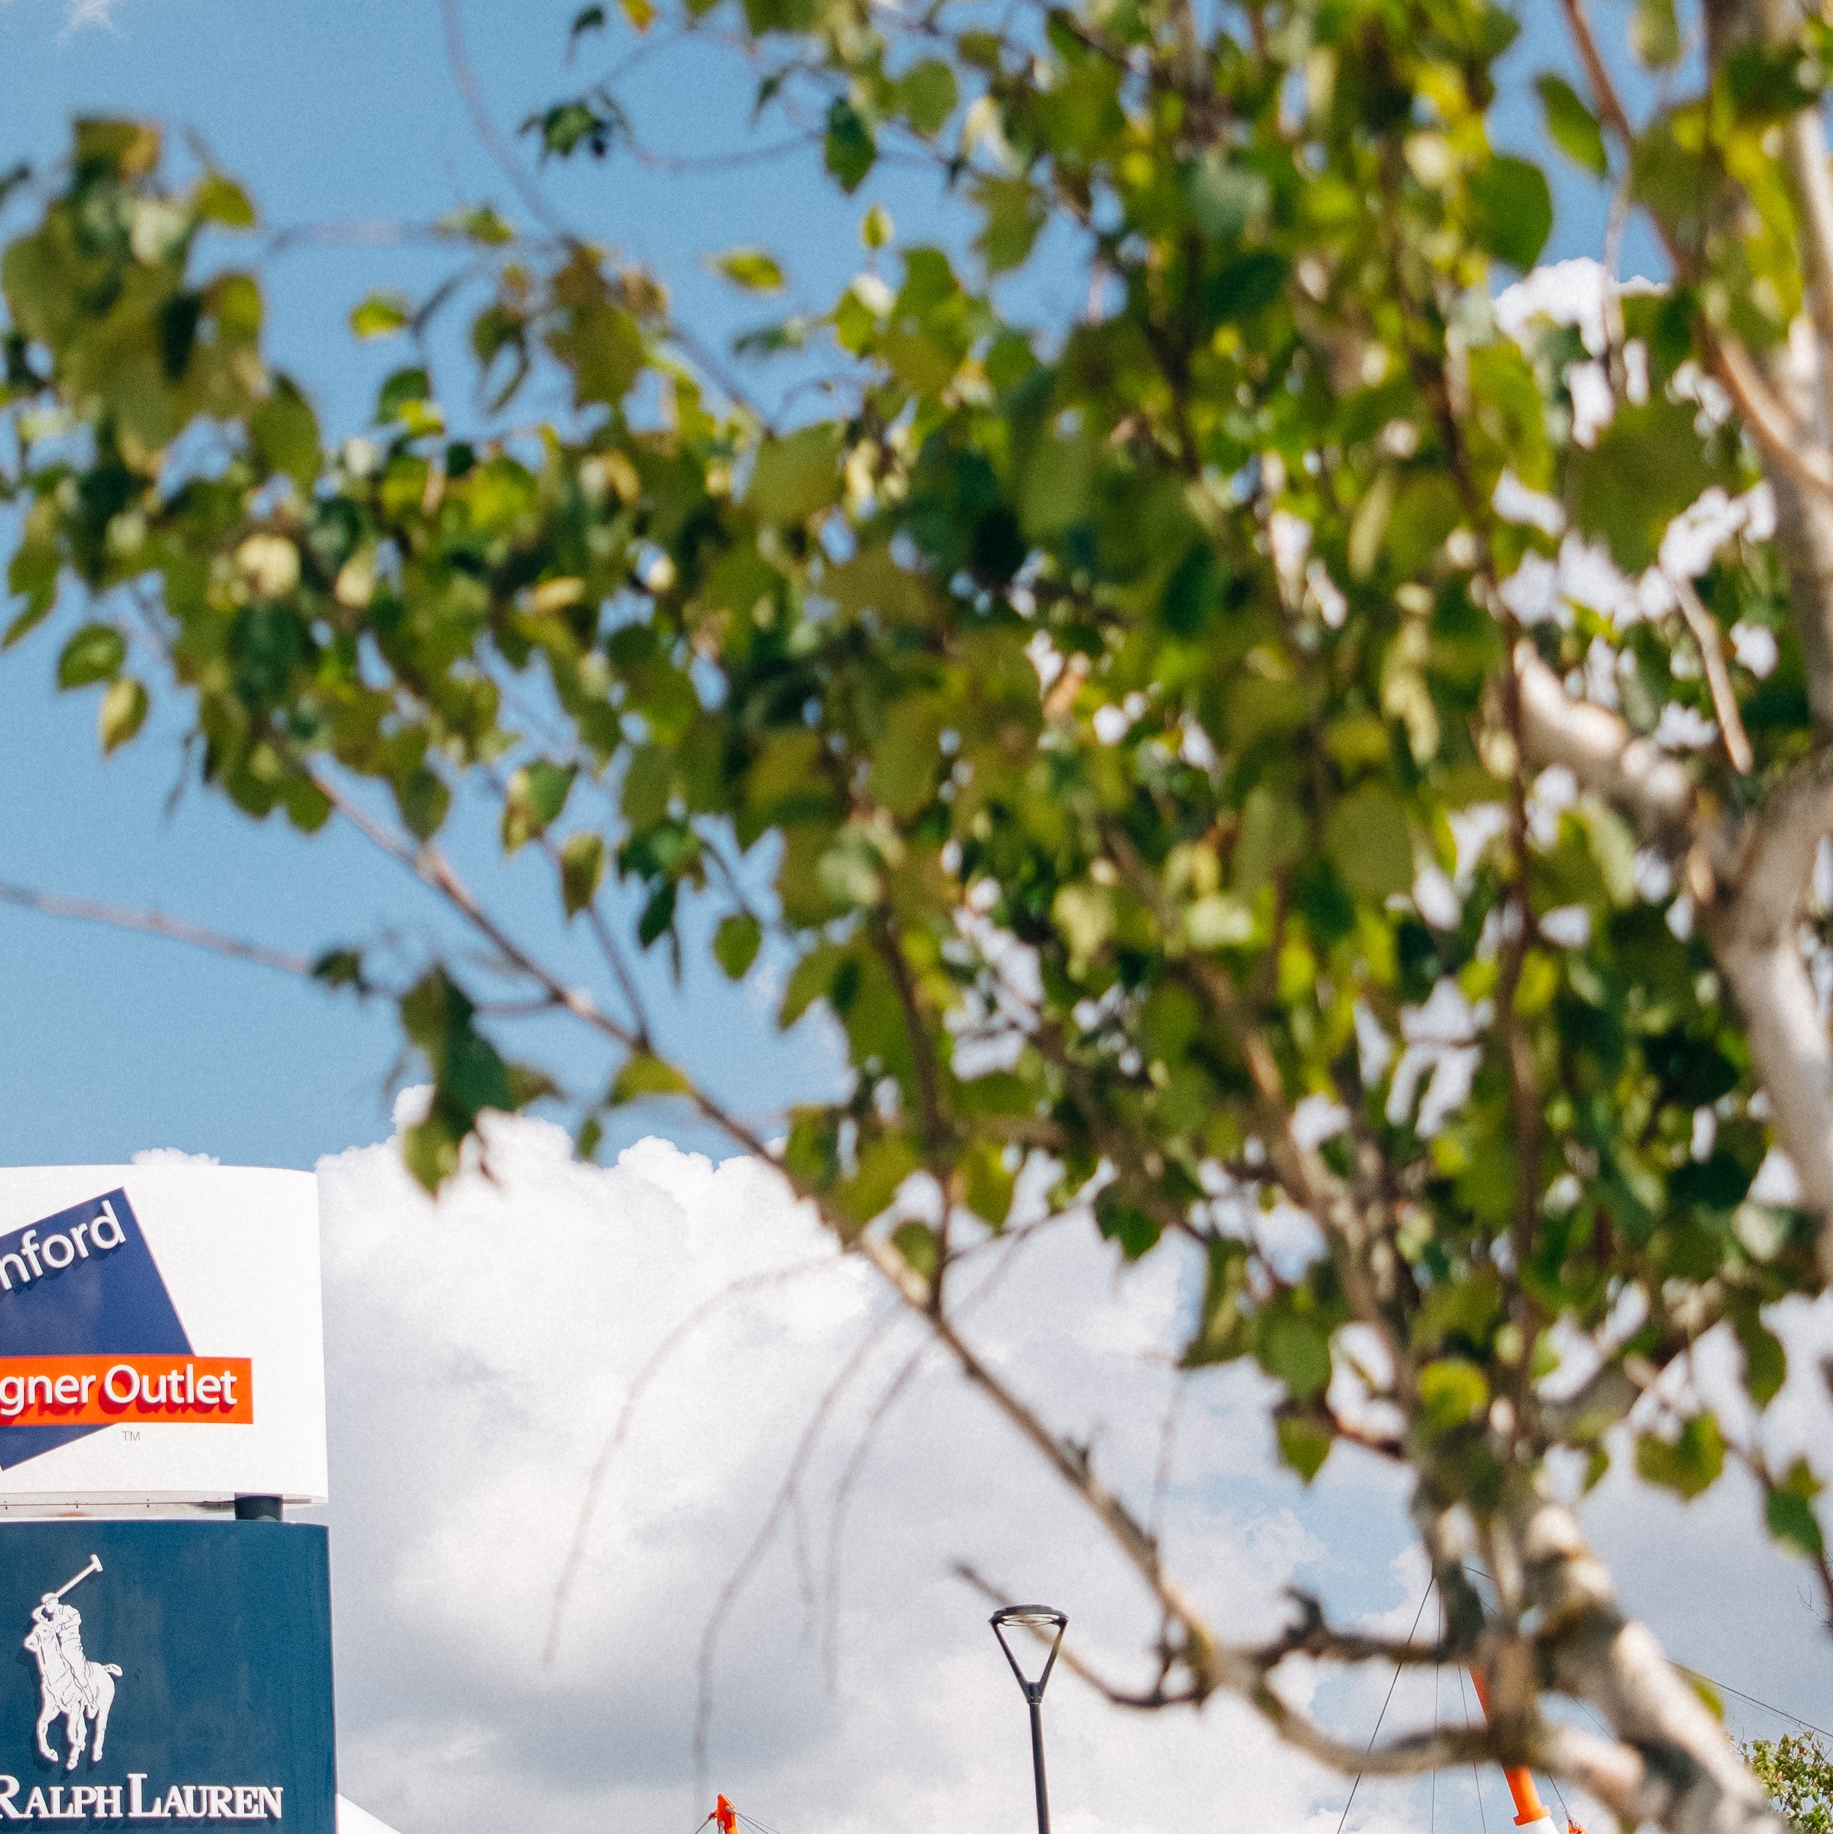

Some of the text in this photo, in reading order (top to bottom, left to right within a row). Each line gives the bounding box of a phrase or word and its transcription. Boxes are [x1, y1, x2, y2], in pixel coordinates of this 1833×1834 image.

[103, 1364, 238, 1406] Outlet
[121, 1431, 141, 1442] TM
[127, 1773, 284, 1819] LAUREN
